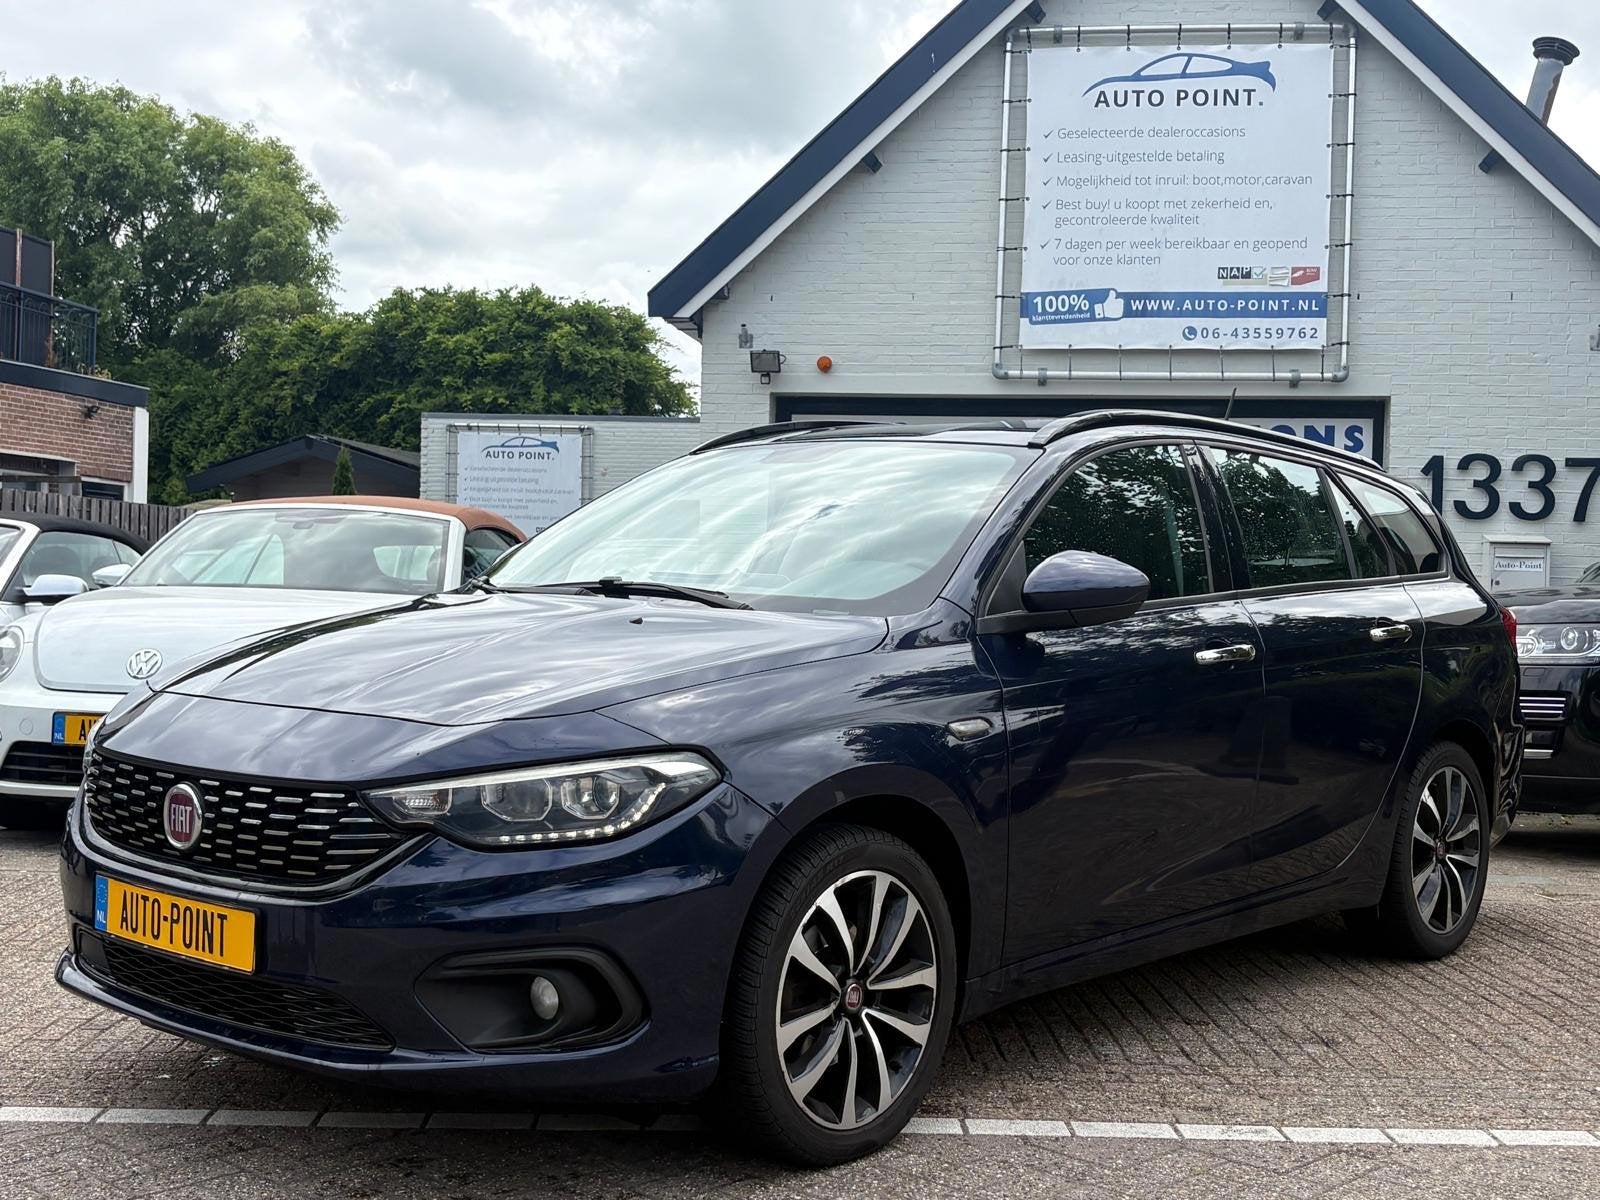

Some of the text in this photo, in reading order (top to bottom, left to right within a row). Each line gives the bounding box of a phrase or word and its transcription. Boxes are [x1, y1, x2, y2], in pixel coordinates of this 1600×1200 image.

[1094, 89, 1165, 108] AUTO
[1057, 126, 1246, 139] Geselecteerde dealeroccasions
[1057, 150, 1225, 165] Leasing-uitgestelde betaling
[1056, 174, 1313, 189] Mogelijkheid tot inruil: boot,motor,caravan
[1055, 198, 1273, 212] Best buy! u koopt met zekerheid en,
[1054, 213, 1200, 229] gecontroleerde kwaliteit
[1054, 236, 1308, 253] 7 dagen per week bereikbaar en geopend
[1053, 253, 1161, 266] voor onze klanten
[1218, 266, 1252, 280] NAP
[1033, 294, 1089, 313] 100%
[1130, 299, 1320, 312] WWW.AUTO-POINT.NL
[1200, 327, 1318, 340] 06-43559762
[485, 451, 515, 460] AUTO
[1420, 453, 1600, 522] 1337
[1495, 561, 1542, 569] Auto-Point
[171, 803, 192, 834] FIAT
[96, 909, 106, 924] NL
[120, 889, 228, 957] AUTO-POINT
